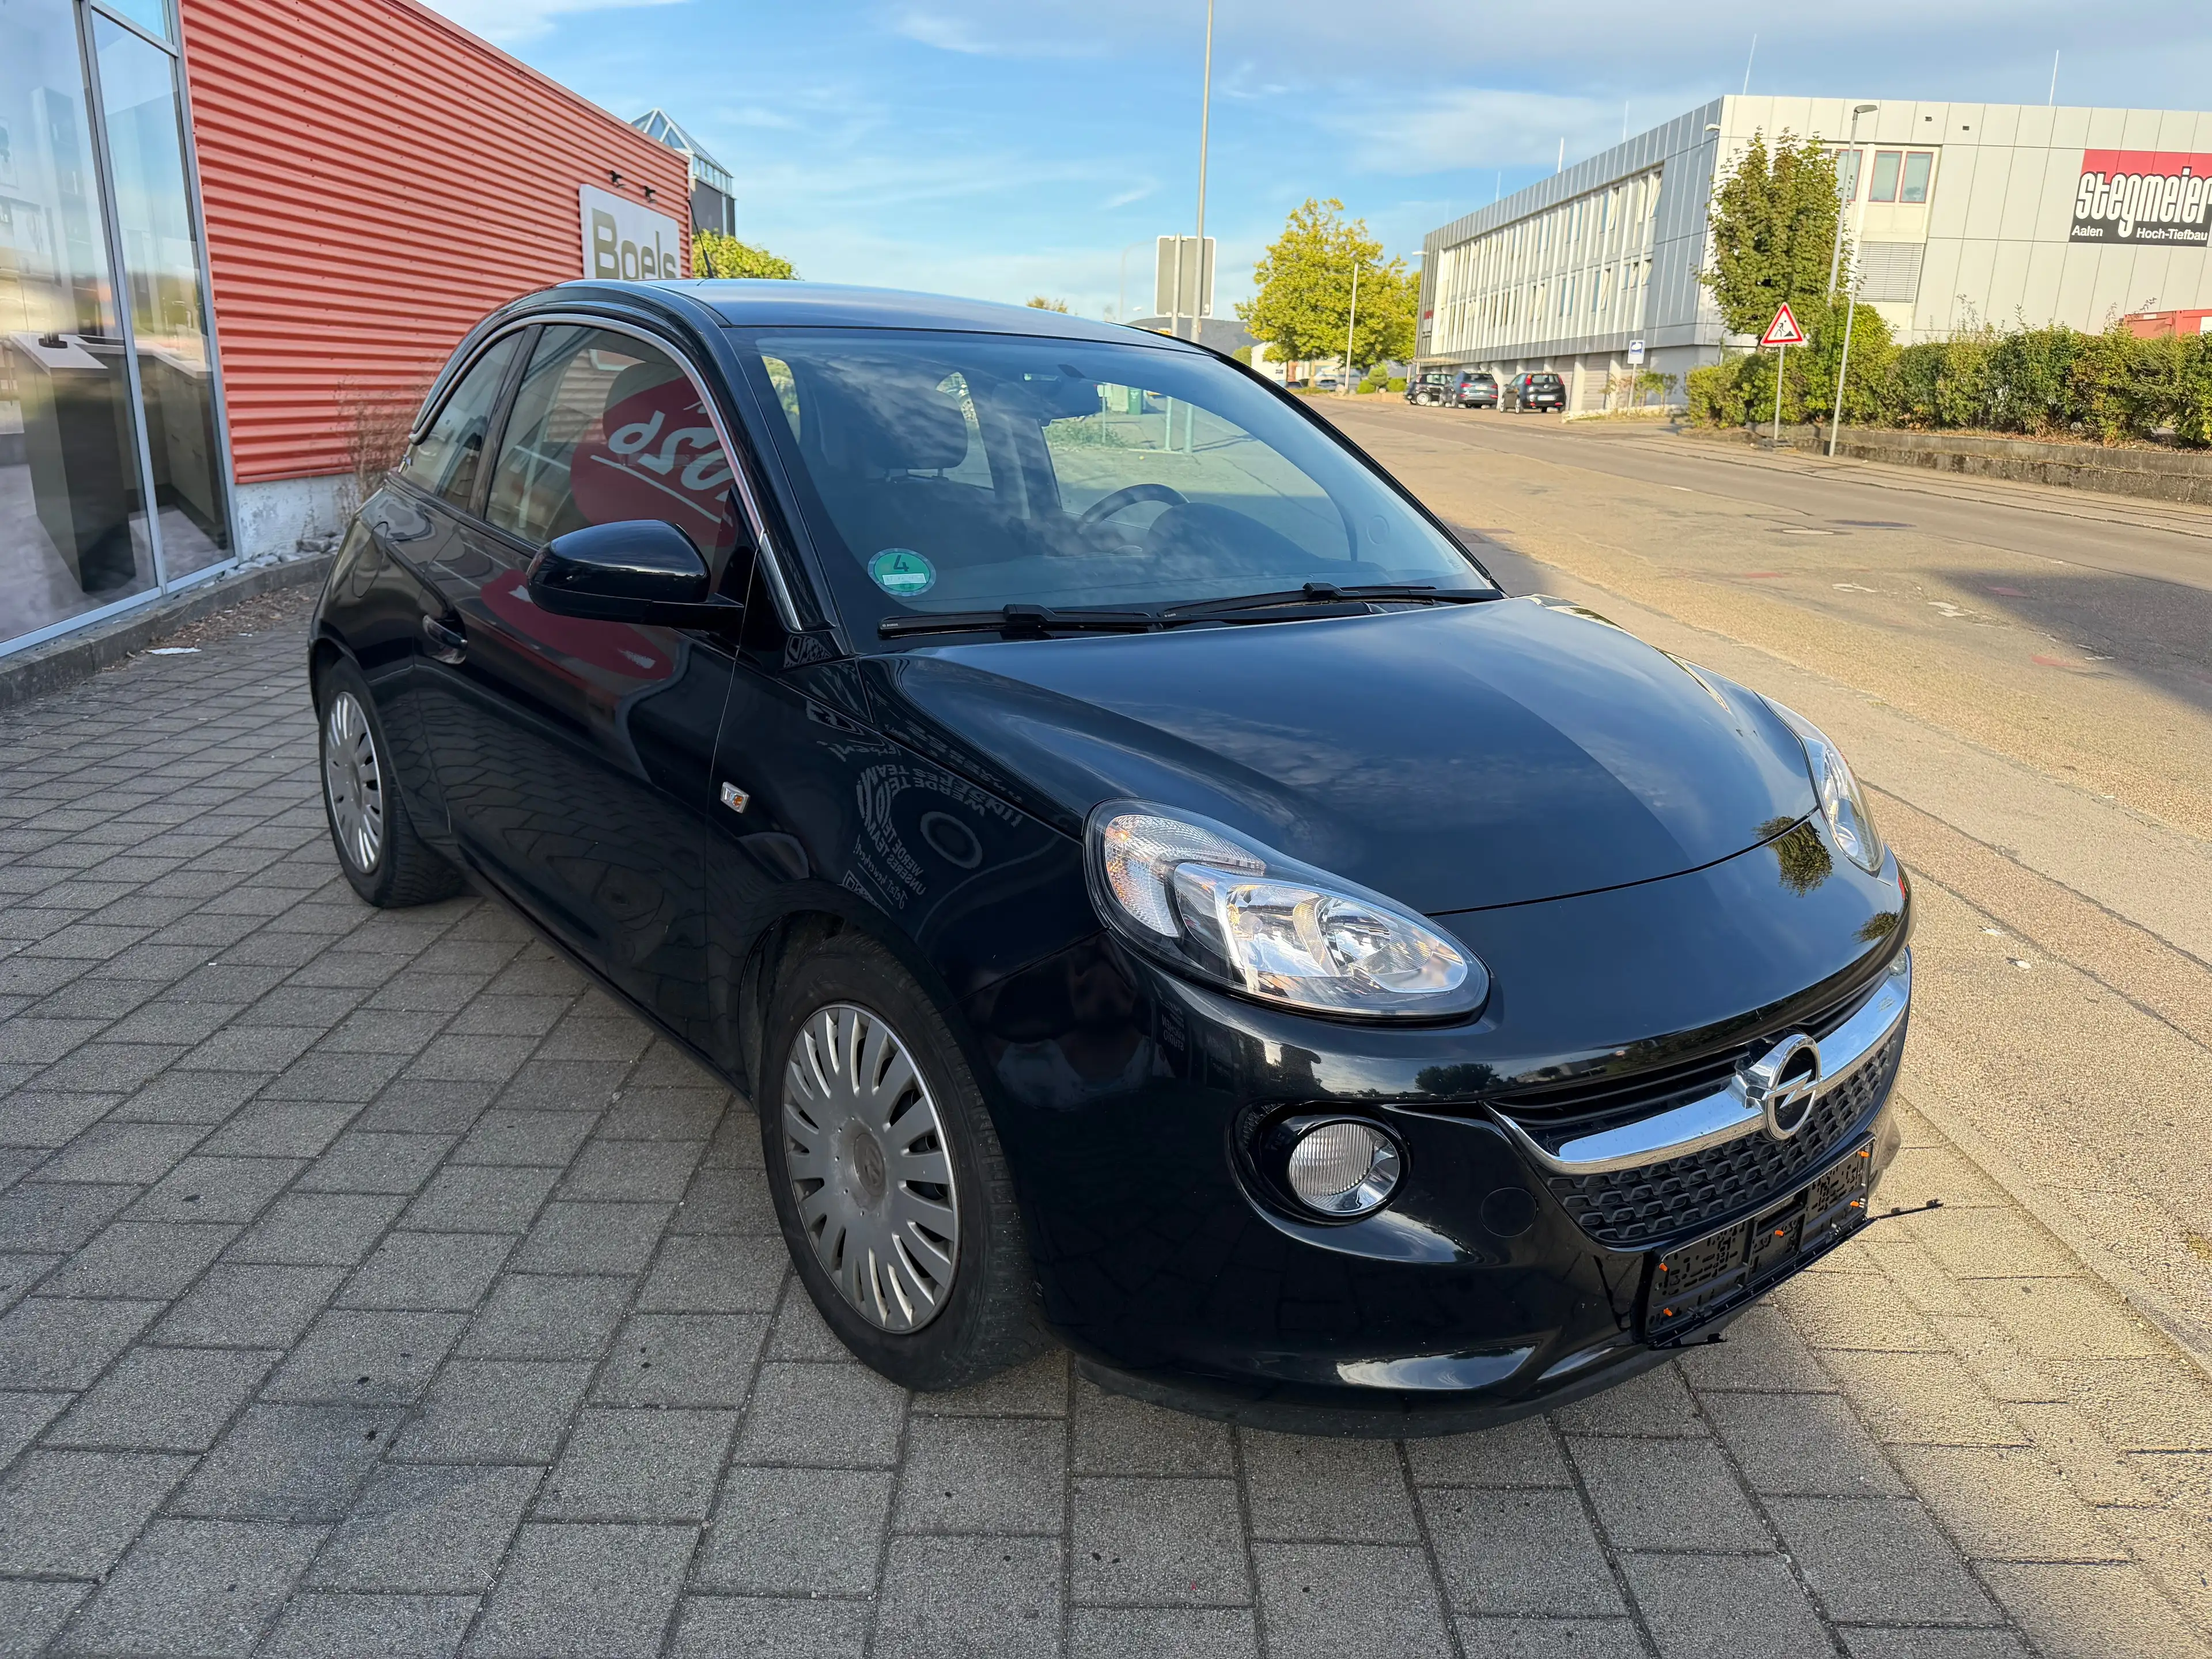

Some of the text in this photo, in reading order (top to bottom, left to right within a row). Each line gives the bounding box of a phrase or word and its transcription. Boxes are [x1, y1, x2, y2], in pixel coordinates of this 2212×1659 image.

[2075, 167, 2212, 237] stegmeier
[592, 208, 676, 279] Boels
[2071, 225, 2208, 241] Aalen Hoch-Tiefbau
[893, 554, 910, 572] 4
